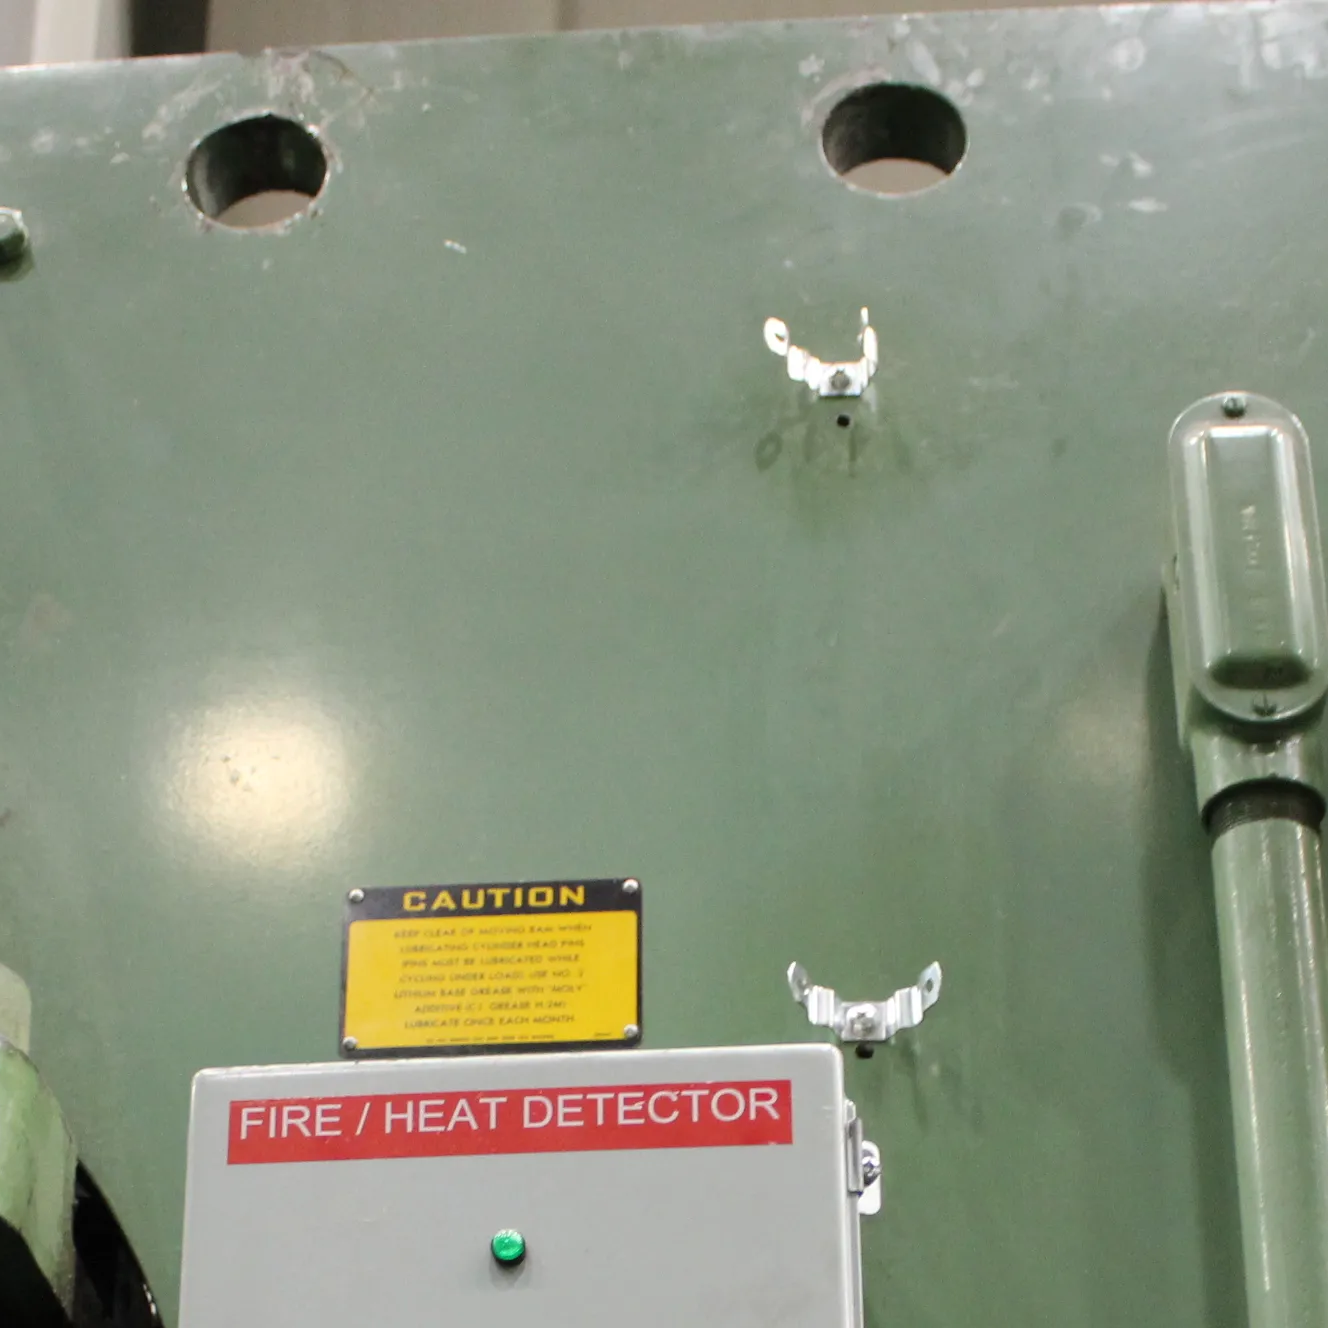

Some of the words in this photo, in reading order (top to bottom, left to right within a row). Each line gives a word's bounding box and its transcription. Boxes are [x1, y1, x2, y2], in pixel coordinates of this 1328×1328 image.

[402, 885, 585, 912] CAUTION
[239, 1103, 343, 1141] FIRE
[355, 1101, 370, 1136] /
[384, 1096, 507, 1135] HEAT
[522, 1087, 780, 1130] DETECTOR
